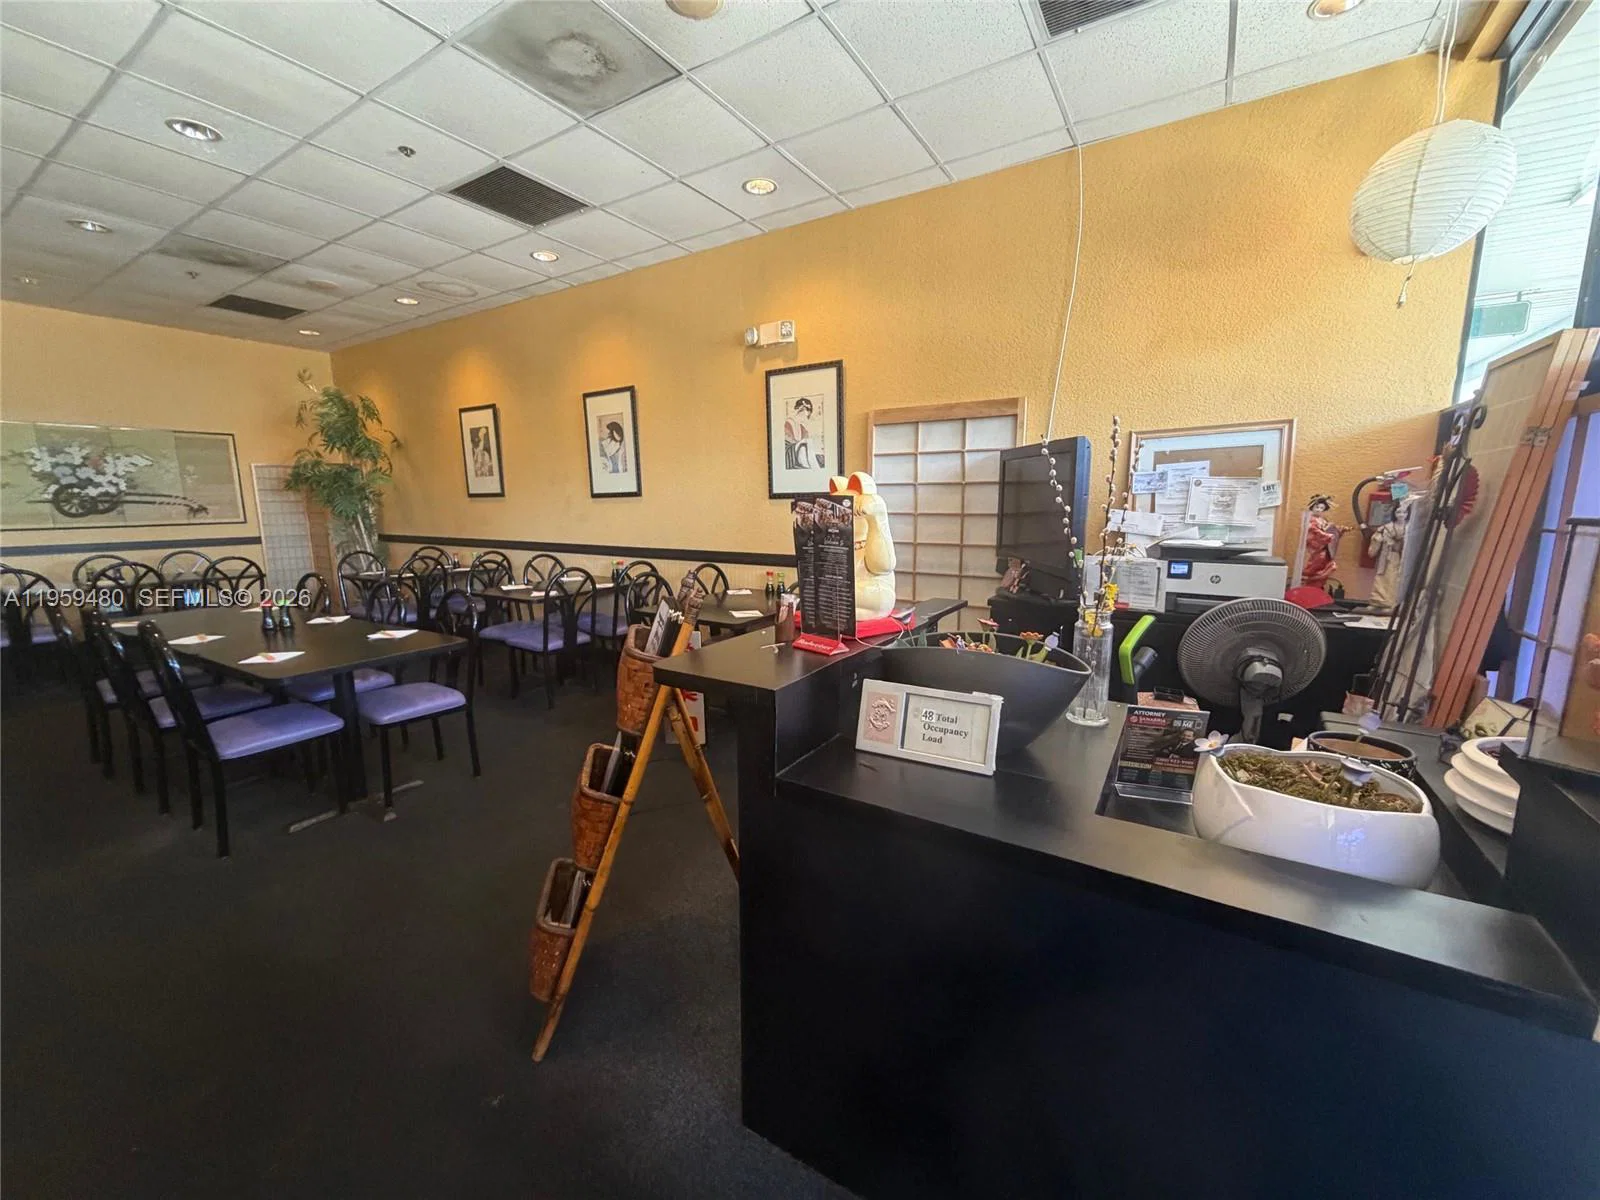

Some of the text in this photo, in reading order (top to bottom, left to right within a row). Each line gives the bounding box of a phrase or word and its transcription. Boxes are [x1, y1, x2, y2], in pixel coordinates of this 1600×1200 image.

[922, 710, 958, 724] 48 Total
[923, 722, 968, 739] Occupancy
[922, 733, 943, 744] Load
